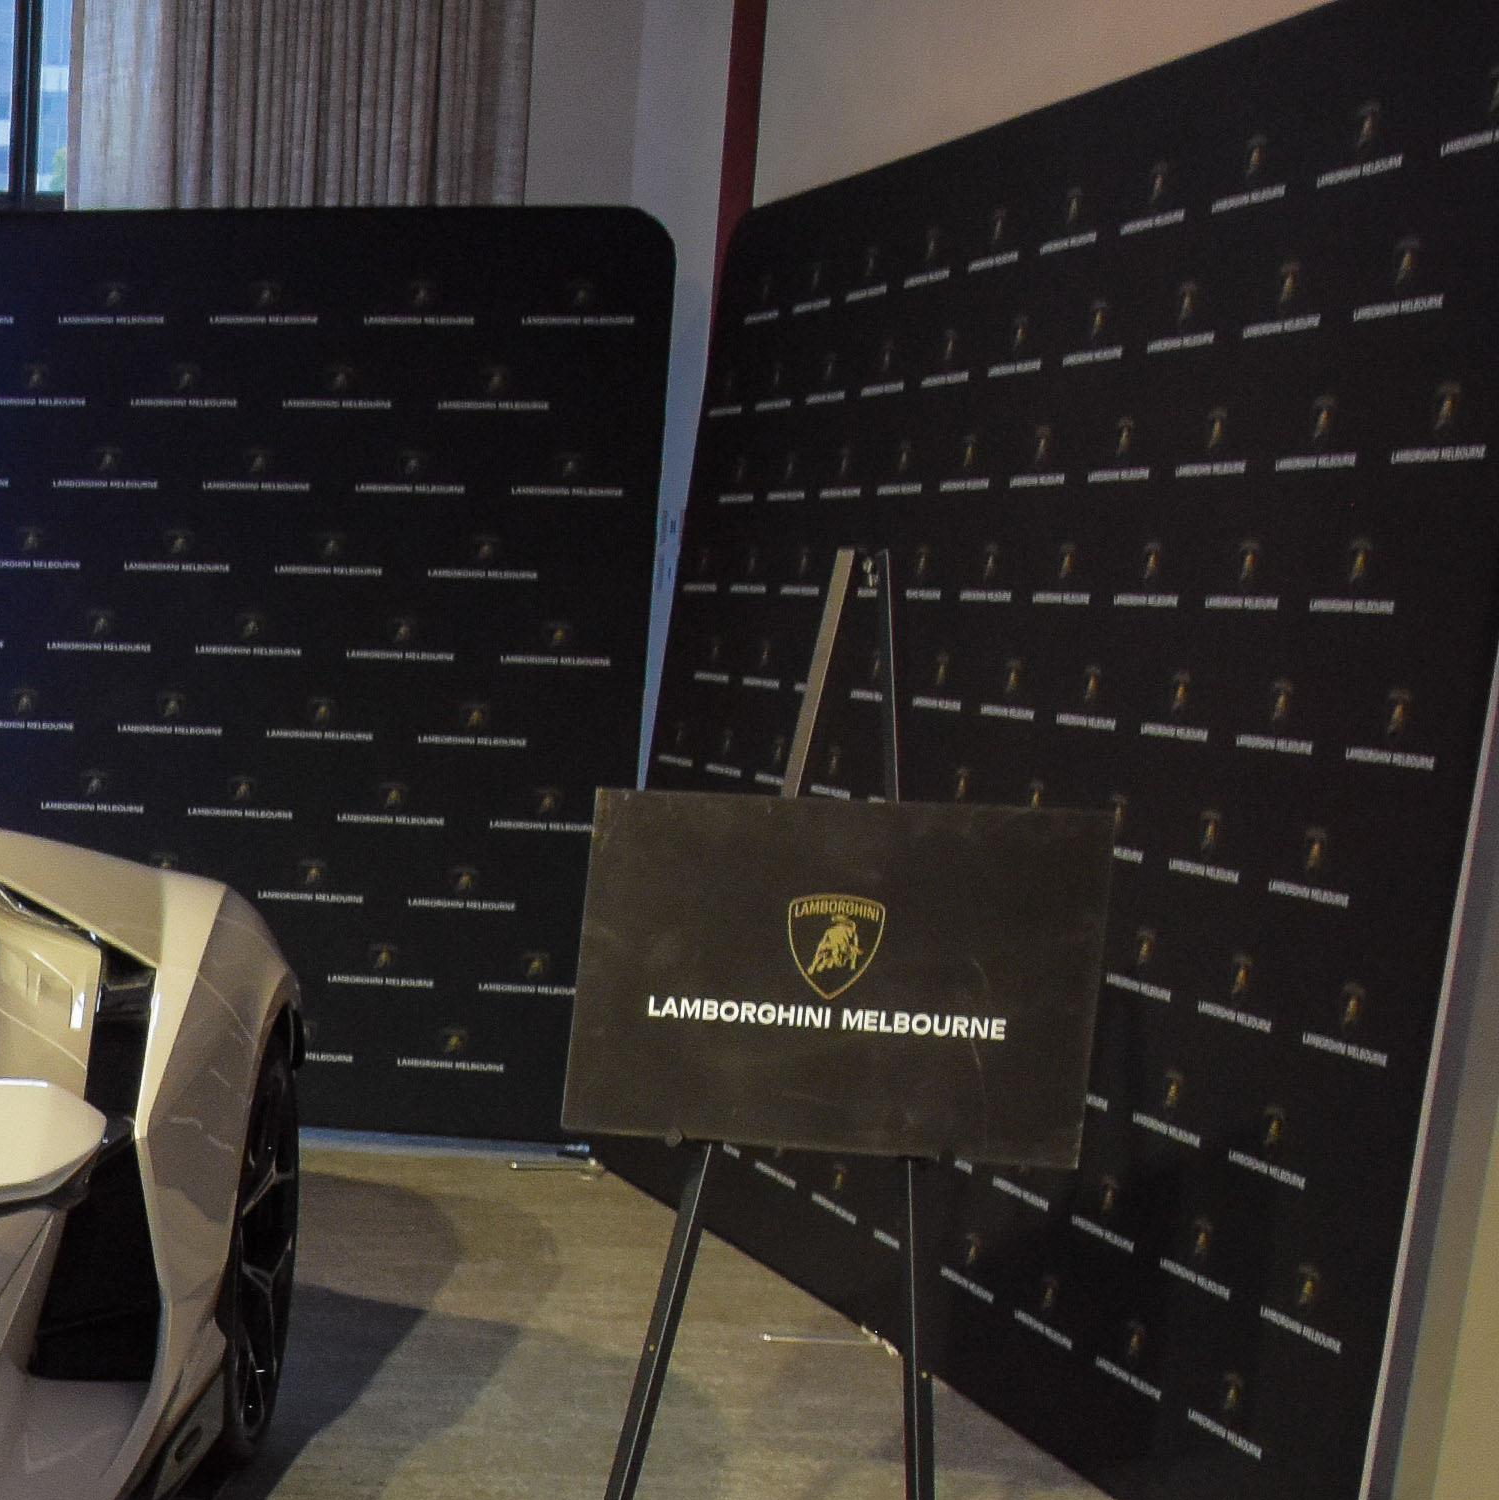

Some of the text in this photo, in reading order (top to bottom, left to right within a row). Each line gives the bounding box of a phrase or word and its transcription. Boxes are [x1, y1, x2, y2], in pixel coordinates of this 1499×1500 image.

[794, 899, 880, 922] LAMBORGHINI
[648, 995, 1006, 1041] LAMBORGHINI MELBOURNE
